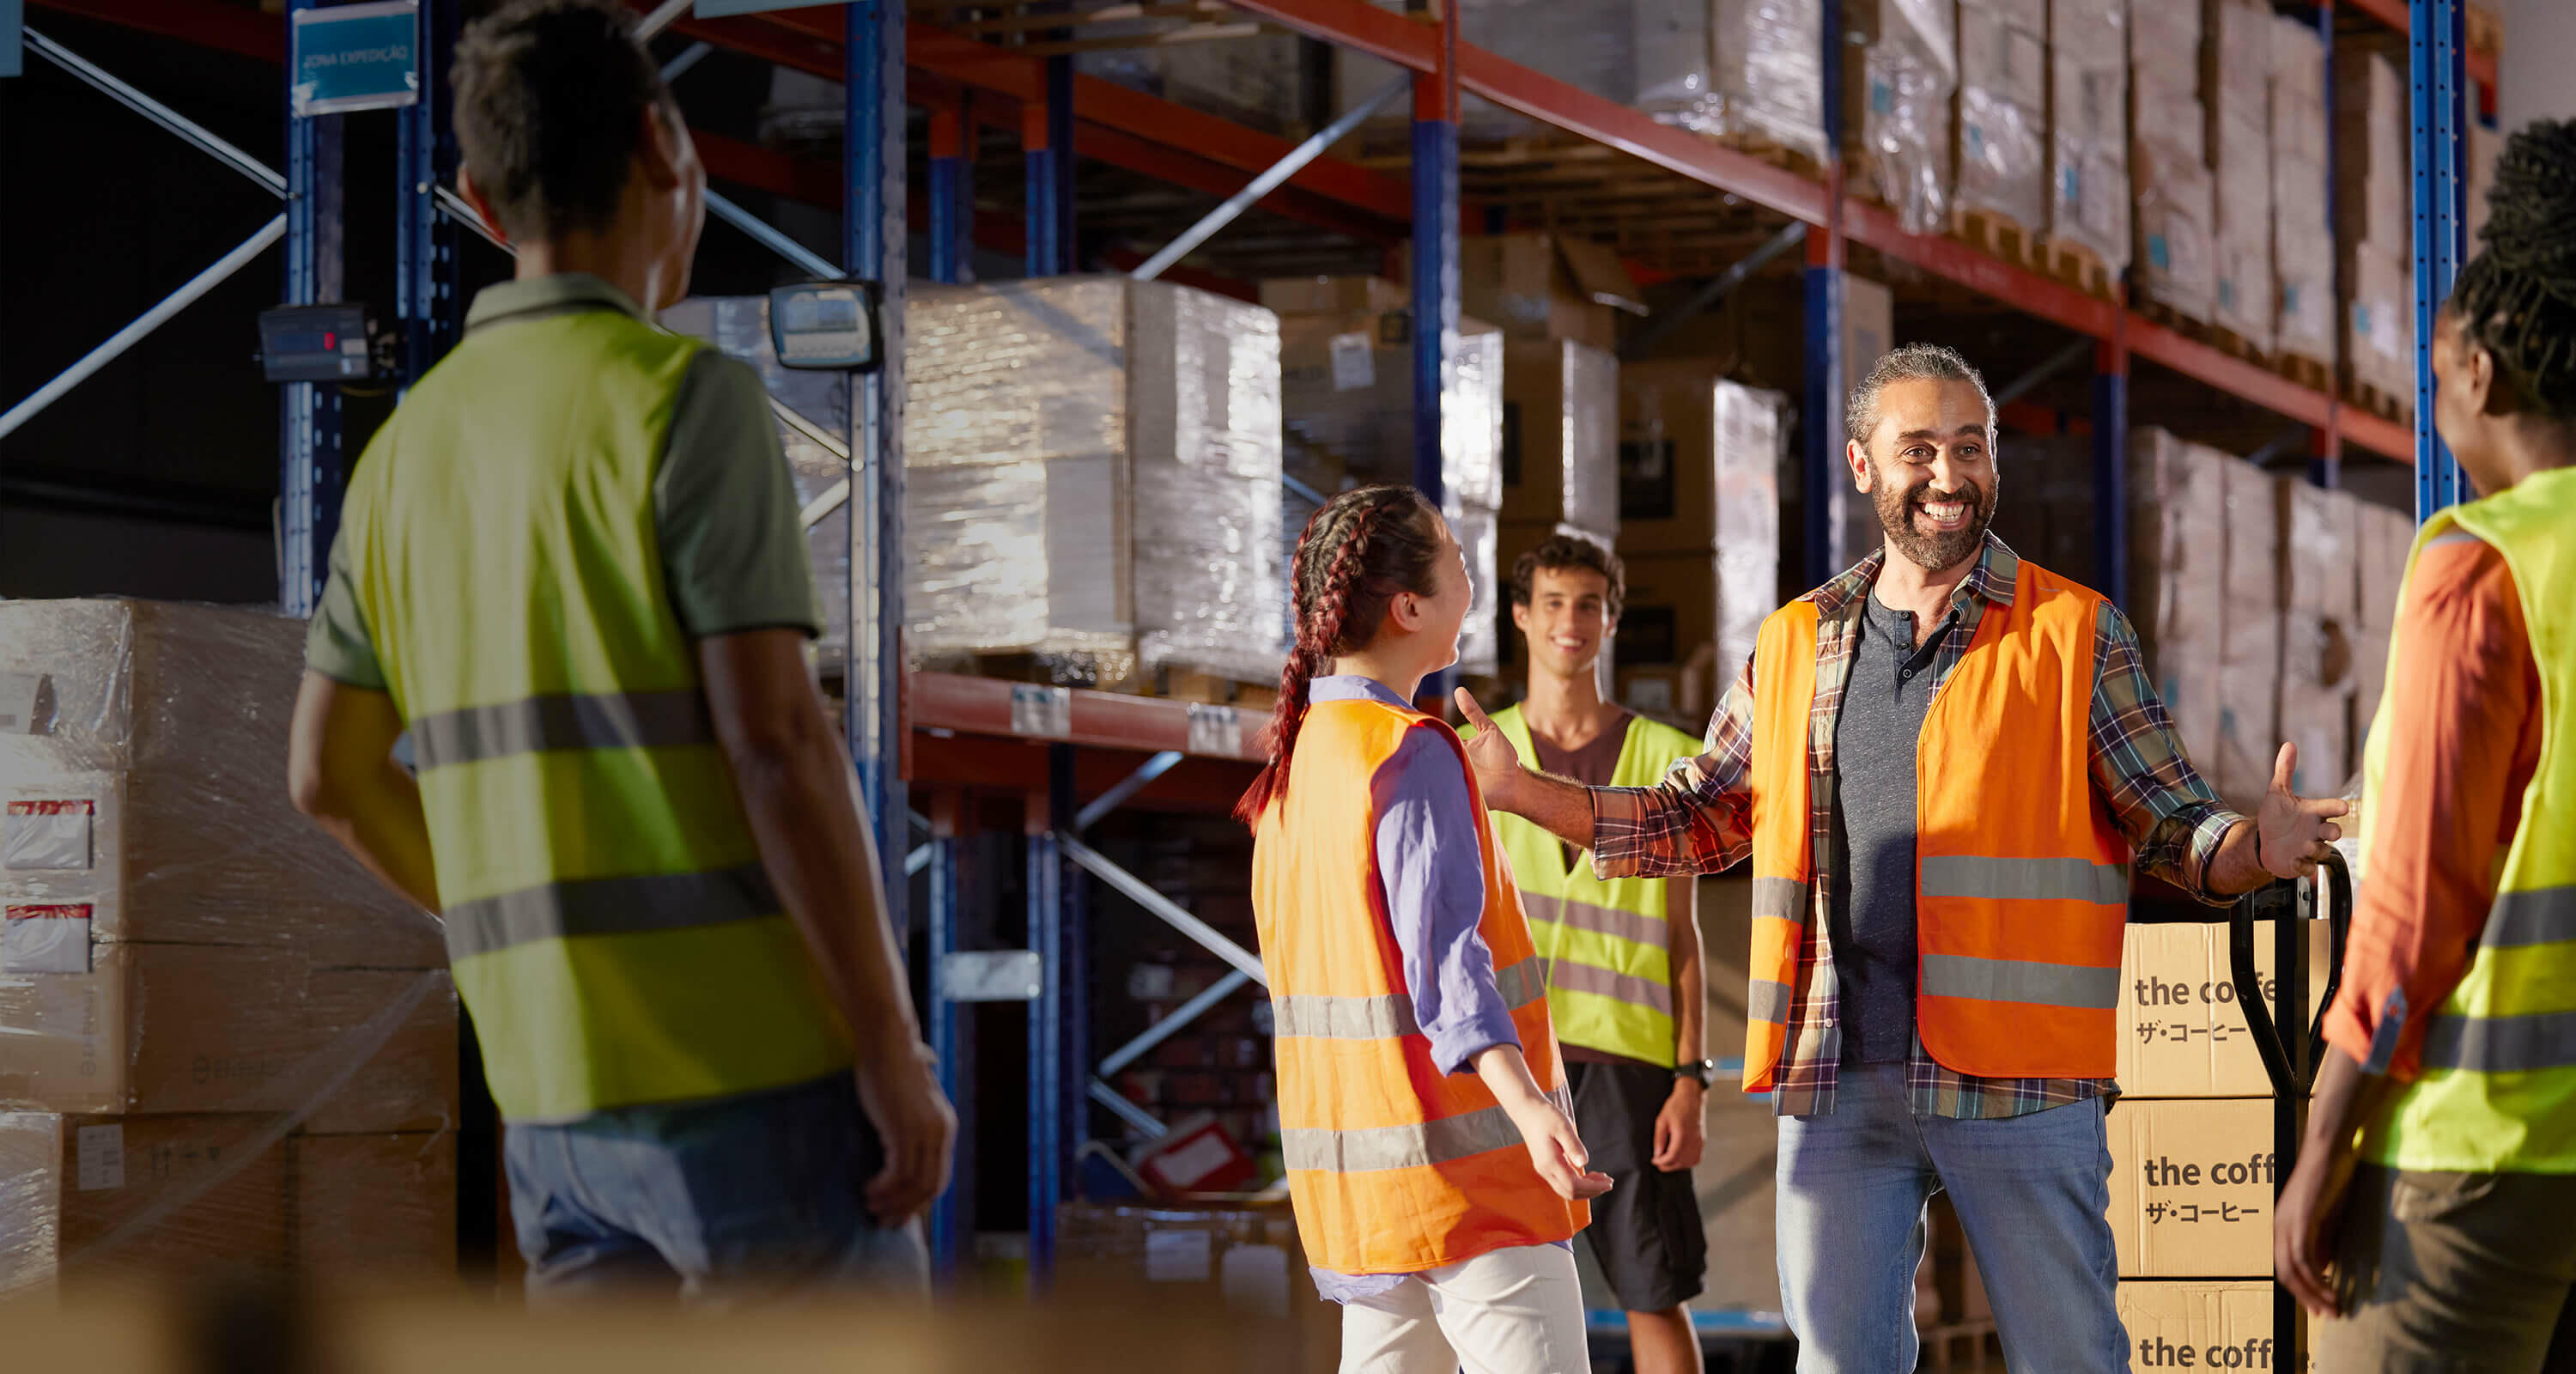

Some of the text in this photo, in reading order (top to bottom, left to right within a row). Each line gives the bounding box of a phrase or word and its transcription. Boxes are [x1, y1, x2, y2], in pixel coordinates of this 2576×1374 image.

[2136, 976, 2190, 1006] the
[2144, 1156, 2201, 1187] the
[2139, 1336, 2196, 1367] the
